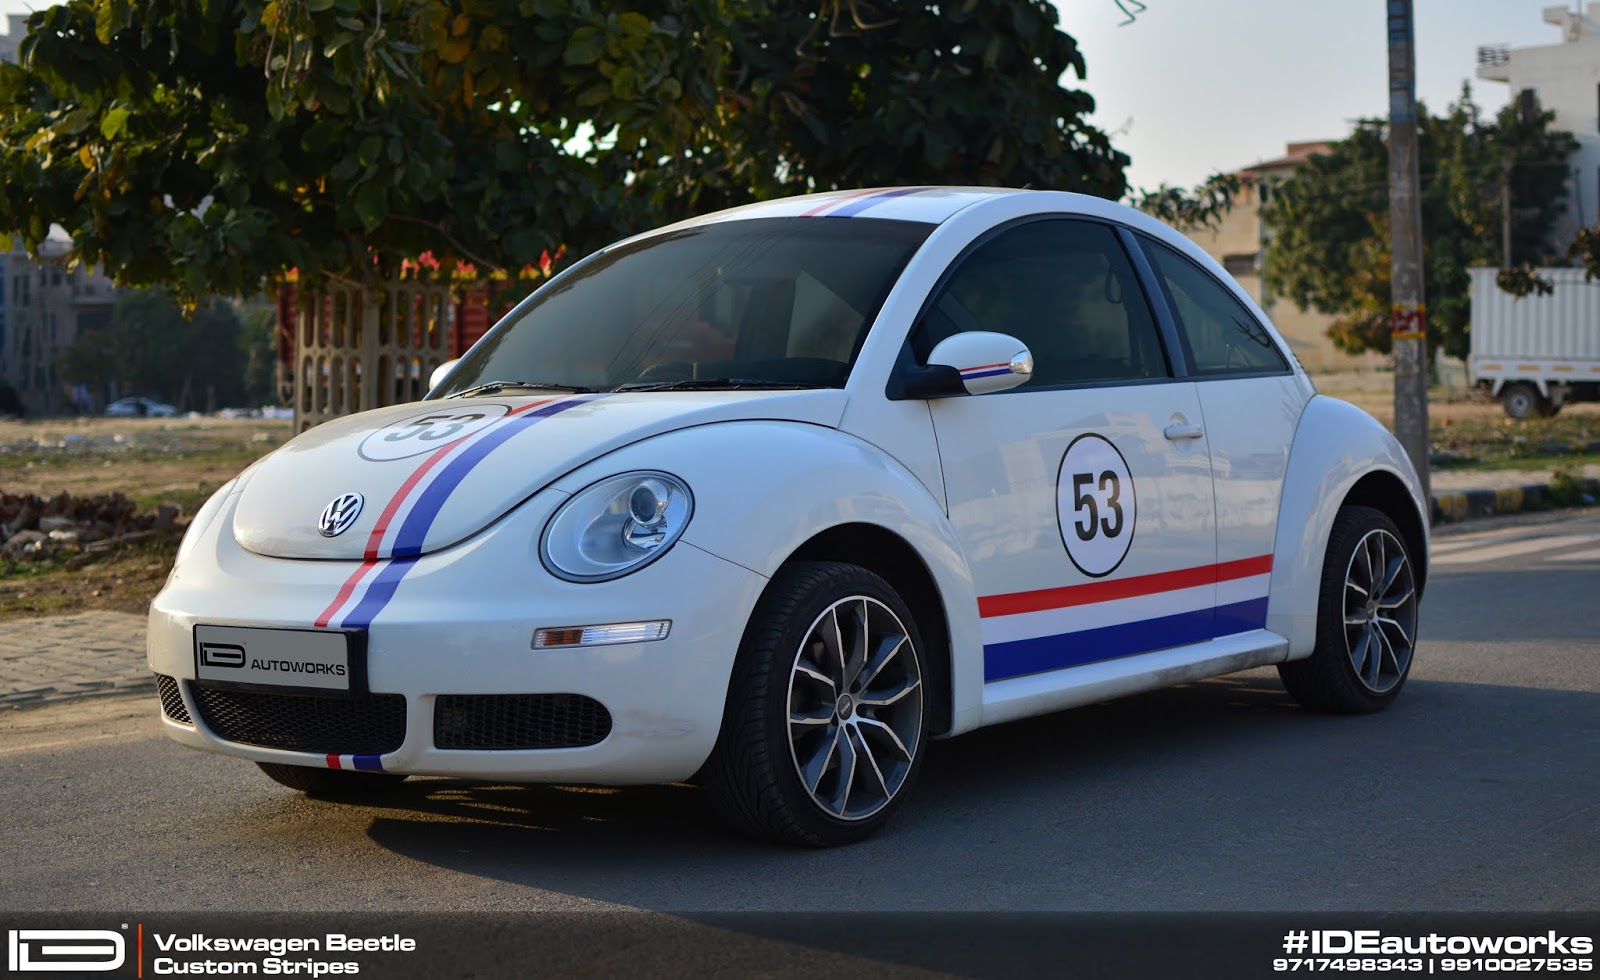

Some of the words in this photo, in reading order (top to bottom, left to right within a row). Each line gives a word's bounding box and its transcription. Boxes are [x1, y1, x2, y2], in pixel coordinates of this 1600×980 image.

[384, 413, 486, 442] 53
[1072, 469, 1124, 542] 53
[251, 658, 346, 676] AUTOWORKS
